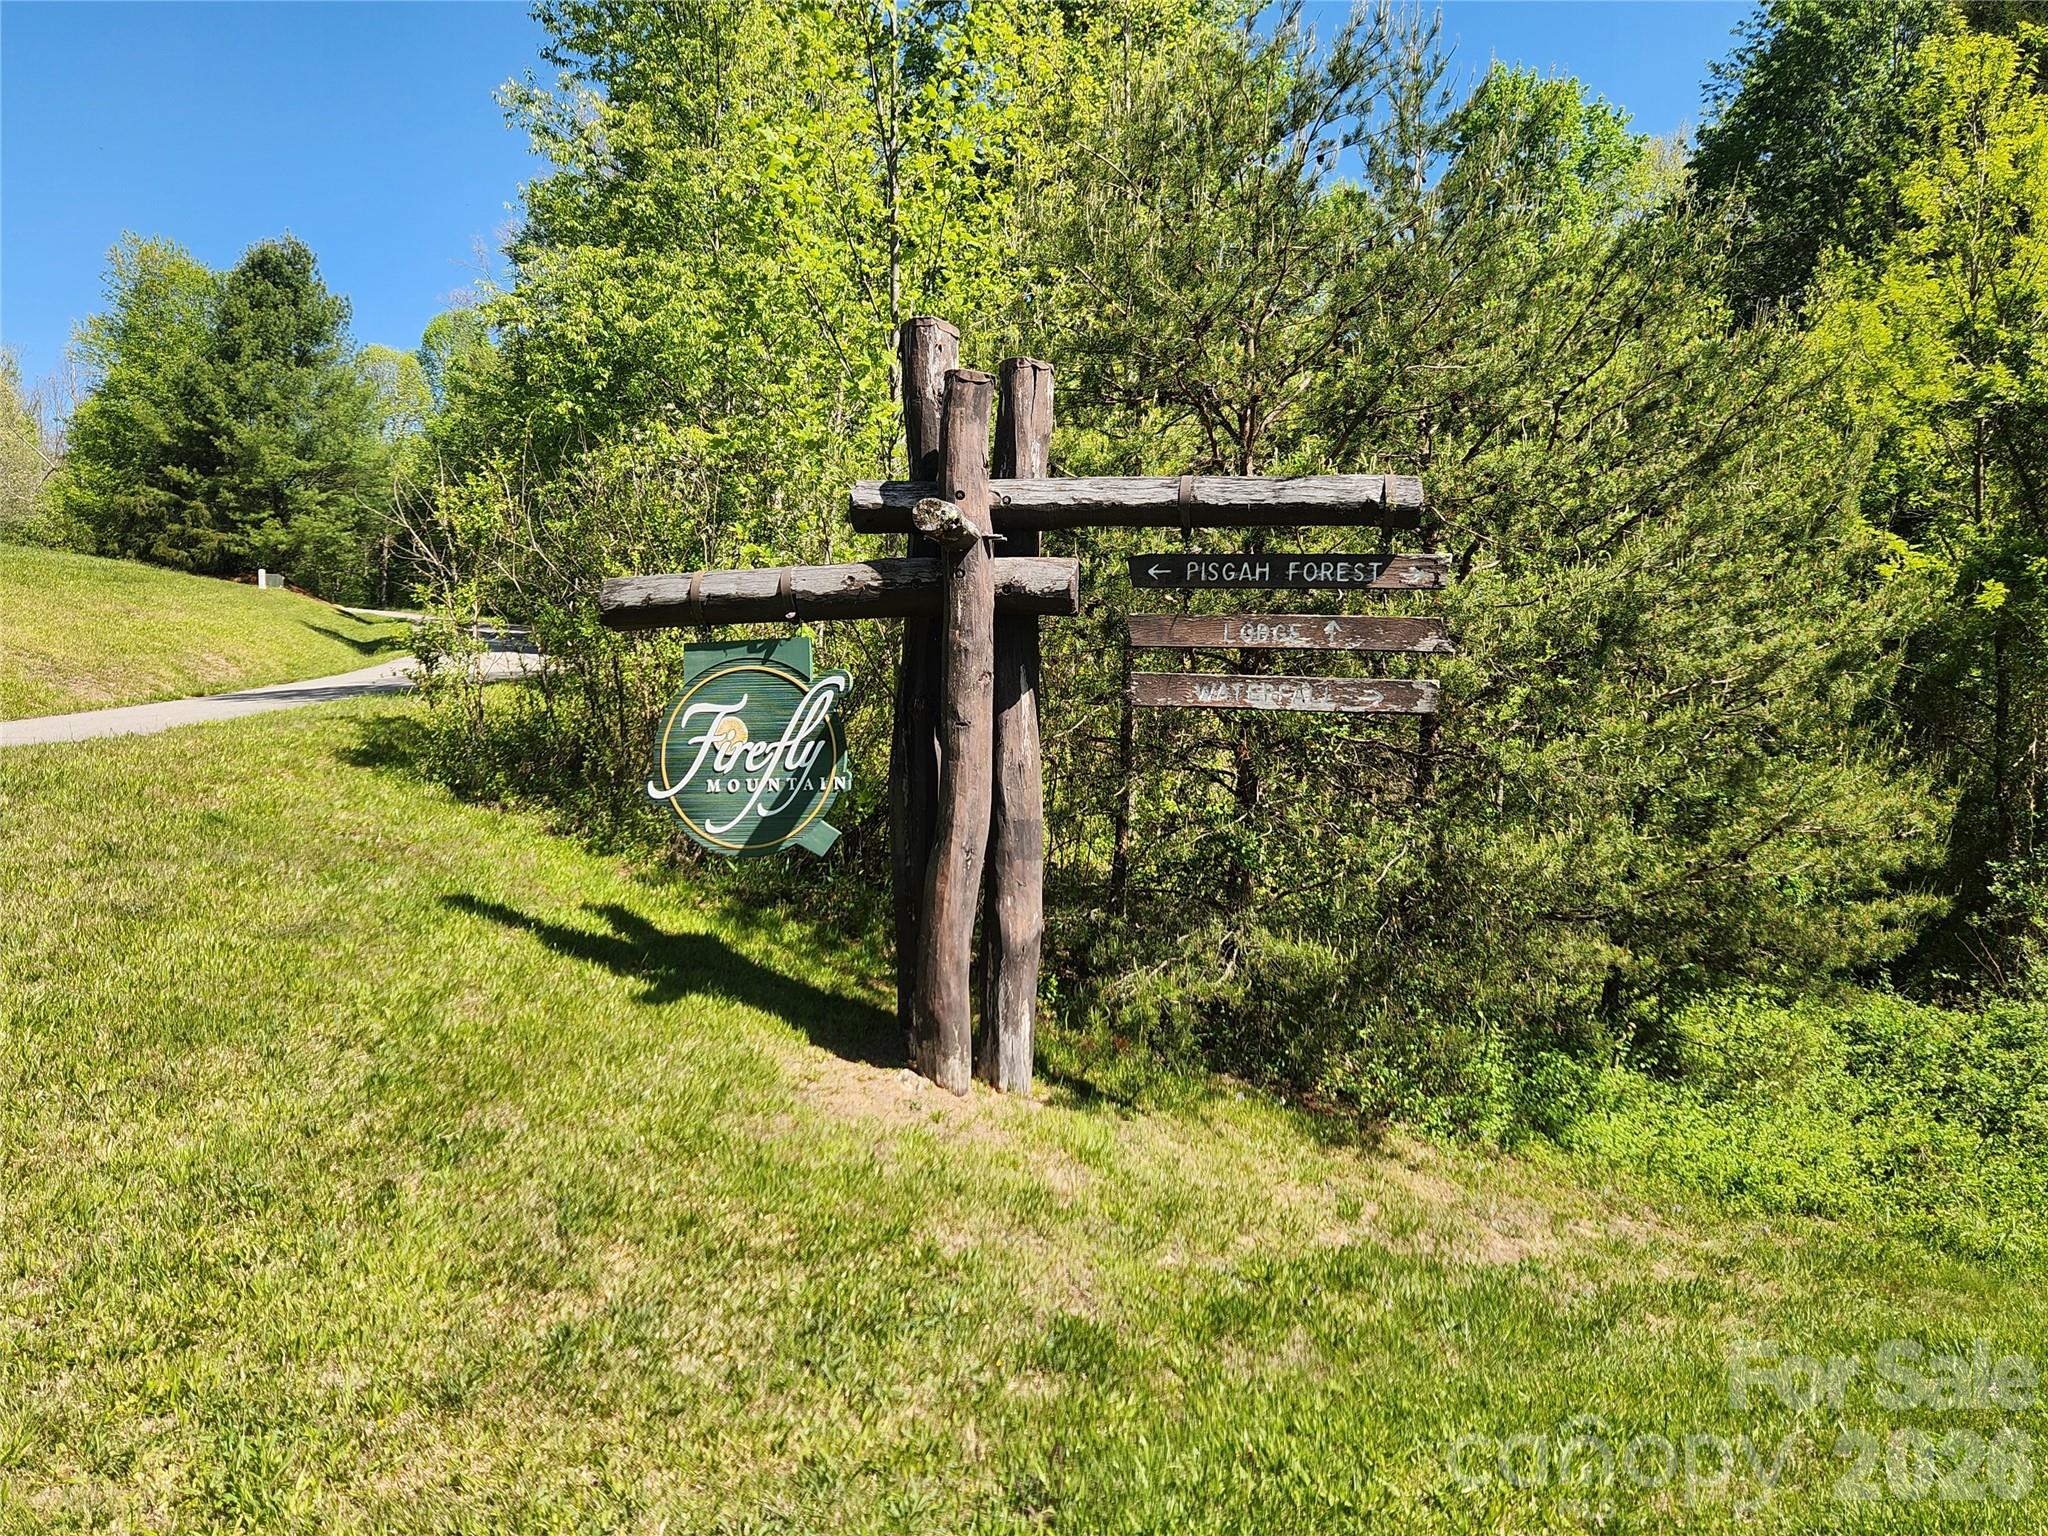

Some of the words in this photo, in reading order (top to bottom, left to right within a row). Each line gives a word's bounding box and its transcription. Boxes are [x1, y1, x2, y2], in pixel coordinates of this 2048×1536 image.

[1186, 562, 1269, 581] PISGAH
[1288, 562, 1383, 582] FOREST
[1223, 623, 1304, 643] LODGE
[648, 676, 845, 833] Firefly
[707, 777, 846, 793] MOUNTAIN
